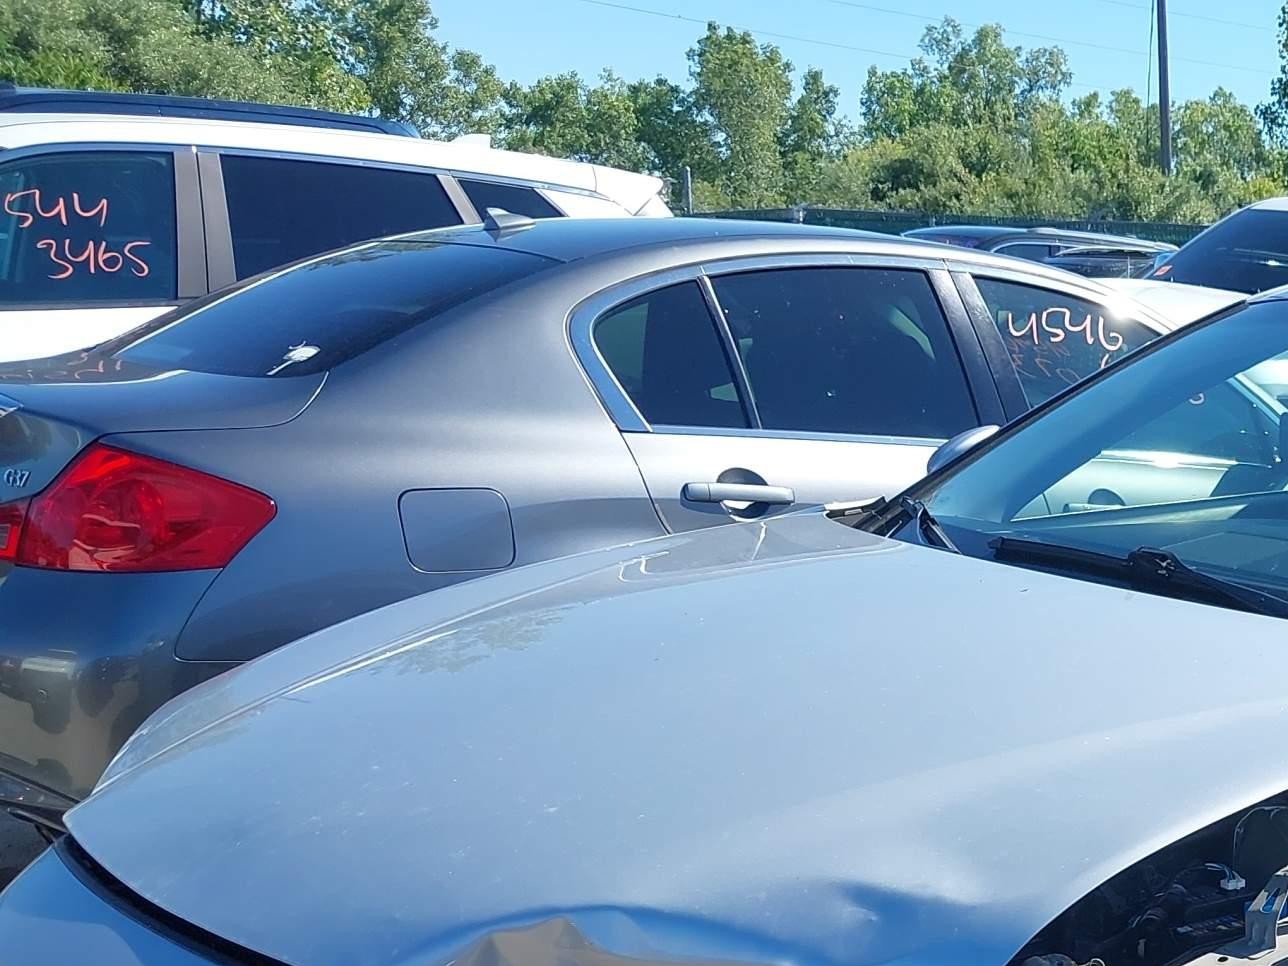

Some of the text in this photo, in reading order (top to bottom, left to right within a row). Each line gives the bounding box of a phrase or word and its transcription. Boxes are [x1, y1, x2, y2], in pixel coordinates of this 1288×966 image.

[36, 238, 152, 279] 3465
[1007, 306, 1124, 352] 4546
[3, 468, 31, 488] G37
